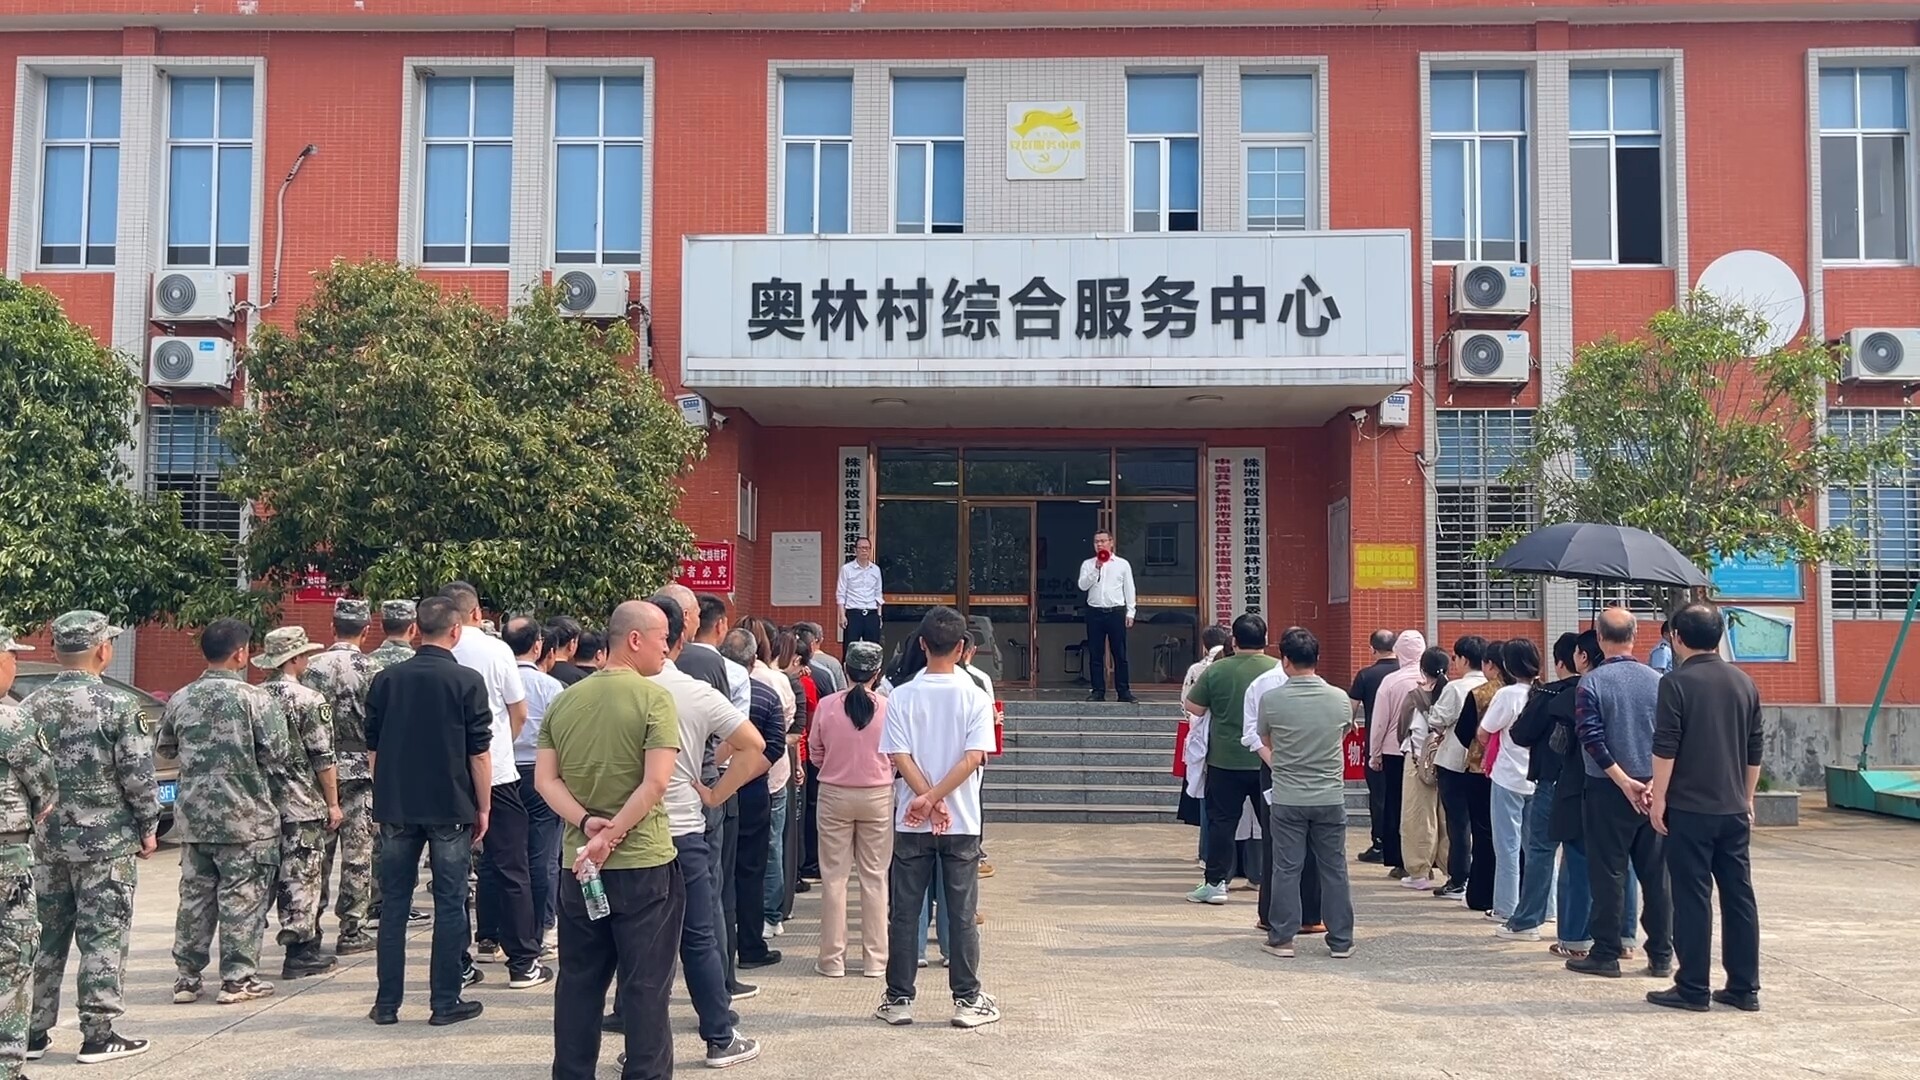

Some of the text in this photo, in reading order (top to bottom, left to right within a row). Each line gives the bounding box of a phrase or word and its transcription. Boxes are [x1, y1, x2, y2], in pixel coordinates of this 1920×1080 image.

[748, 275, 1341, 342] 奥林村综合服务中心
[1347, 740, 1365, 767] 物
